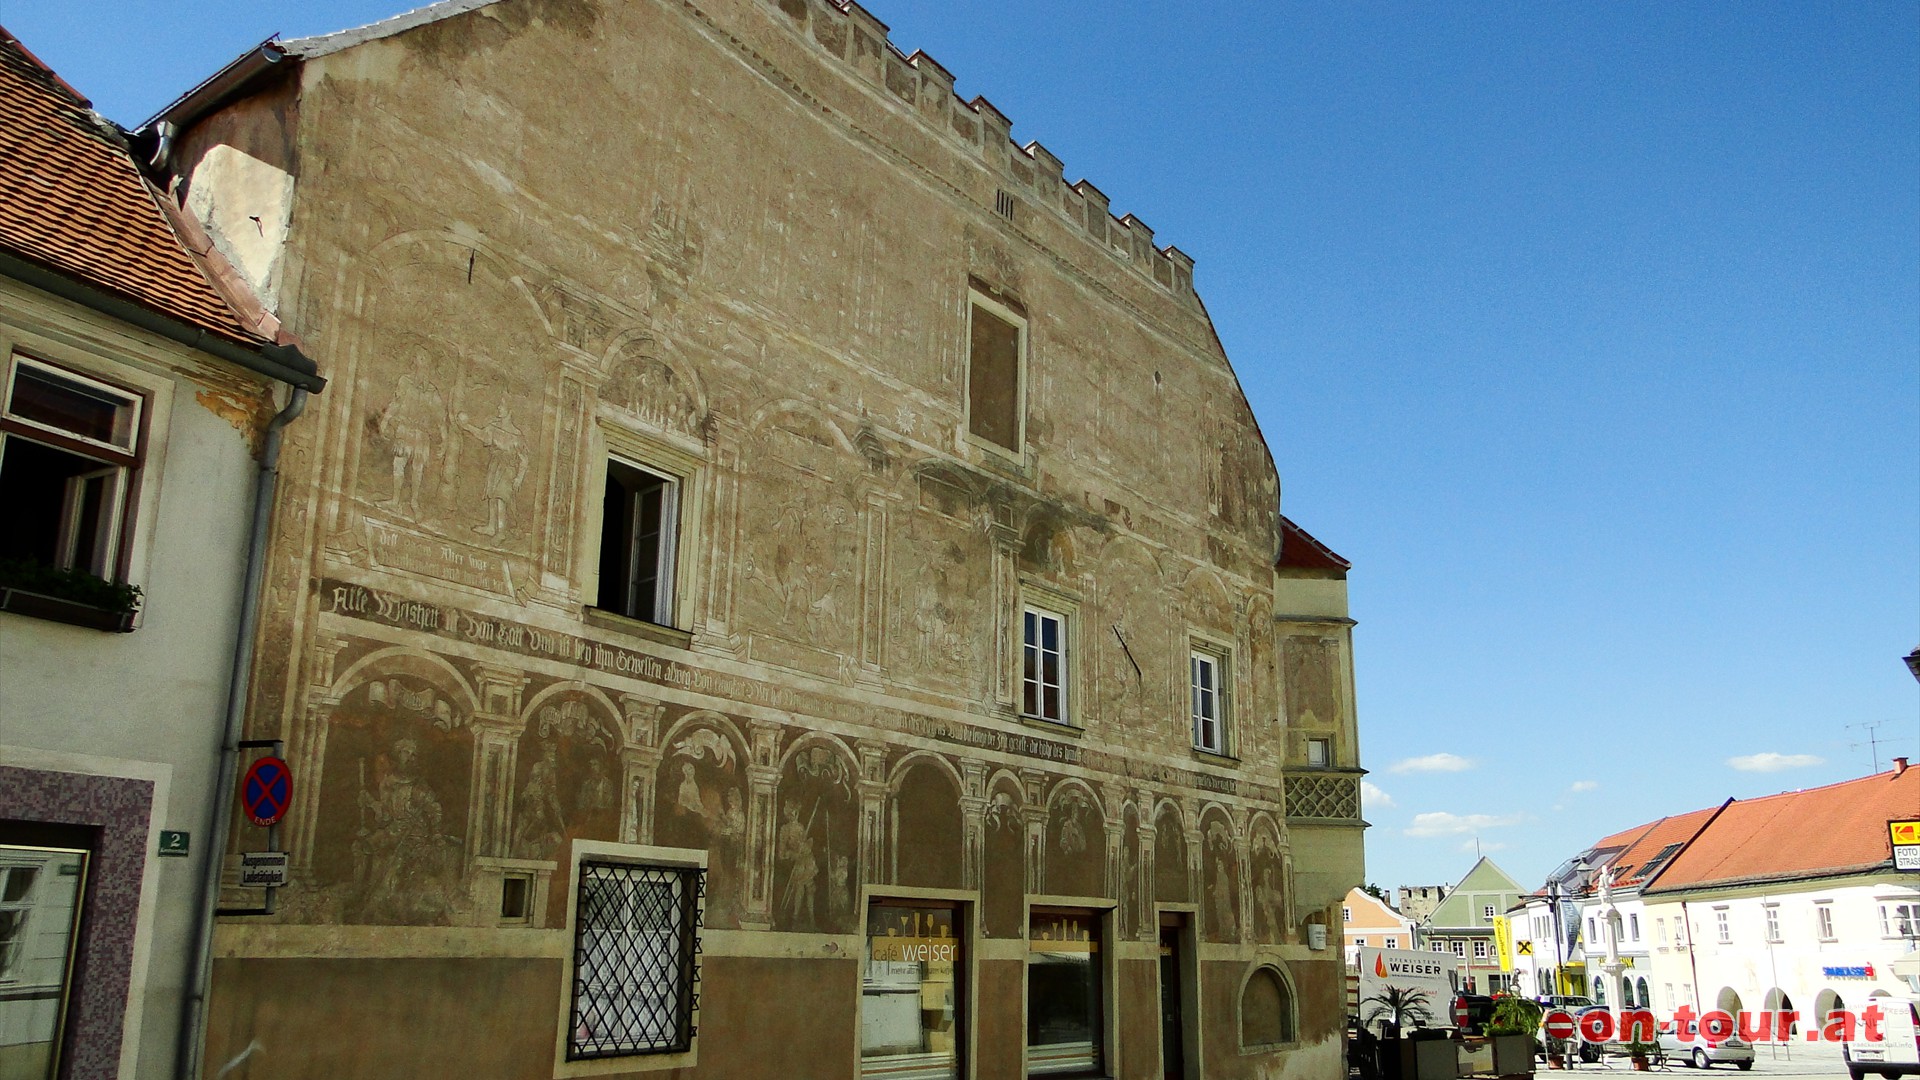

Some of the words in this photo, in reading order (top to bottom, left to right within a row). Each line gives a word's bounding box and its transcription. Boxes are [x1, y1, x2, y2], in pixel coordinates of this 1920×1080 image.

[254, 815, 277, 826] ENDE
[170, 833, 181, 848] 2
[1896, 848, 1918, 857] FOTO
[242, 854, 286, 869] Ausgenommen
[243, 870, 284, 886] Ladetätigkeit
[873, 943, 898, 974] café
[901, 938, 957, 962] weiser
[1389, 962, 1441, 975] WEISER
